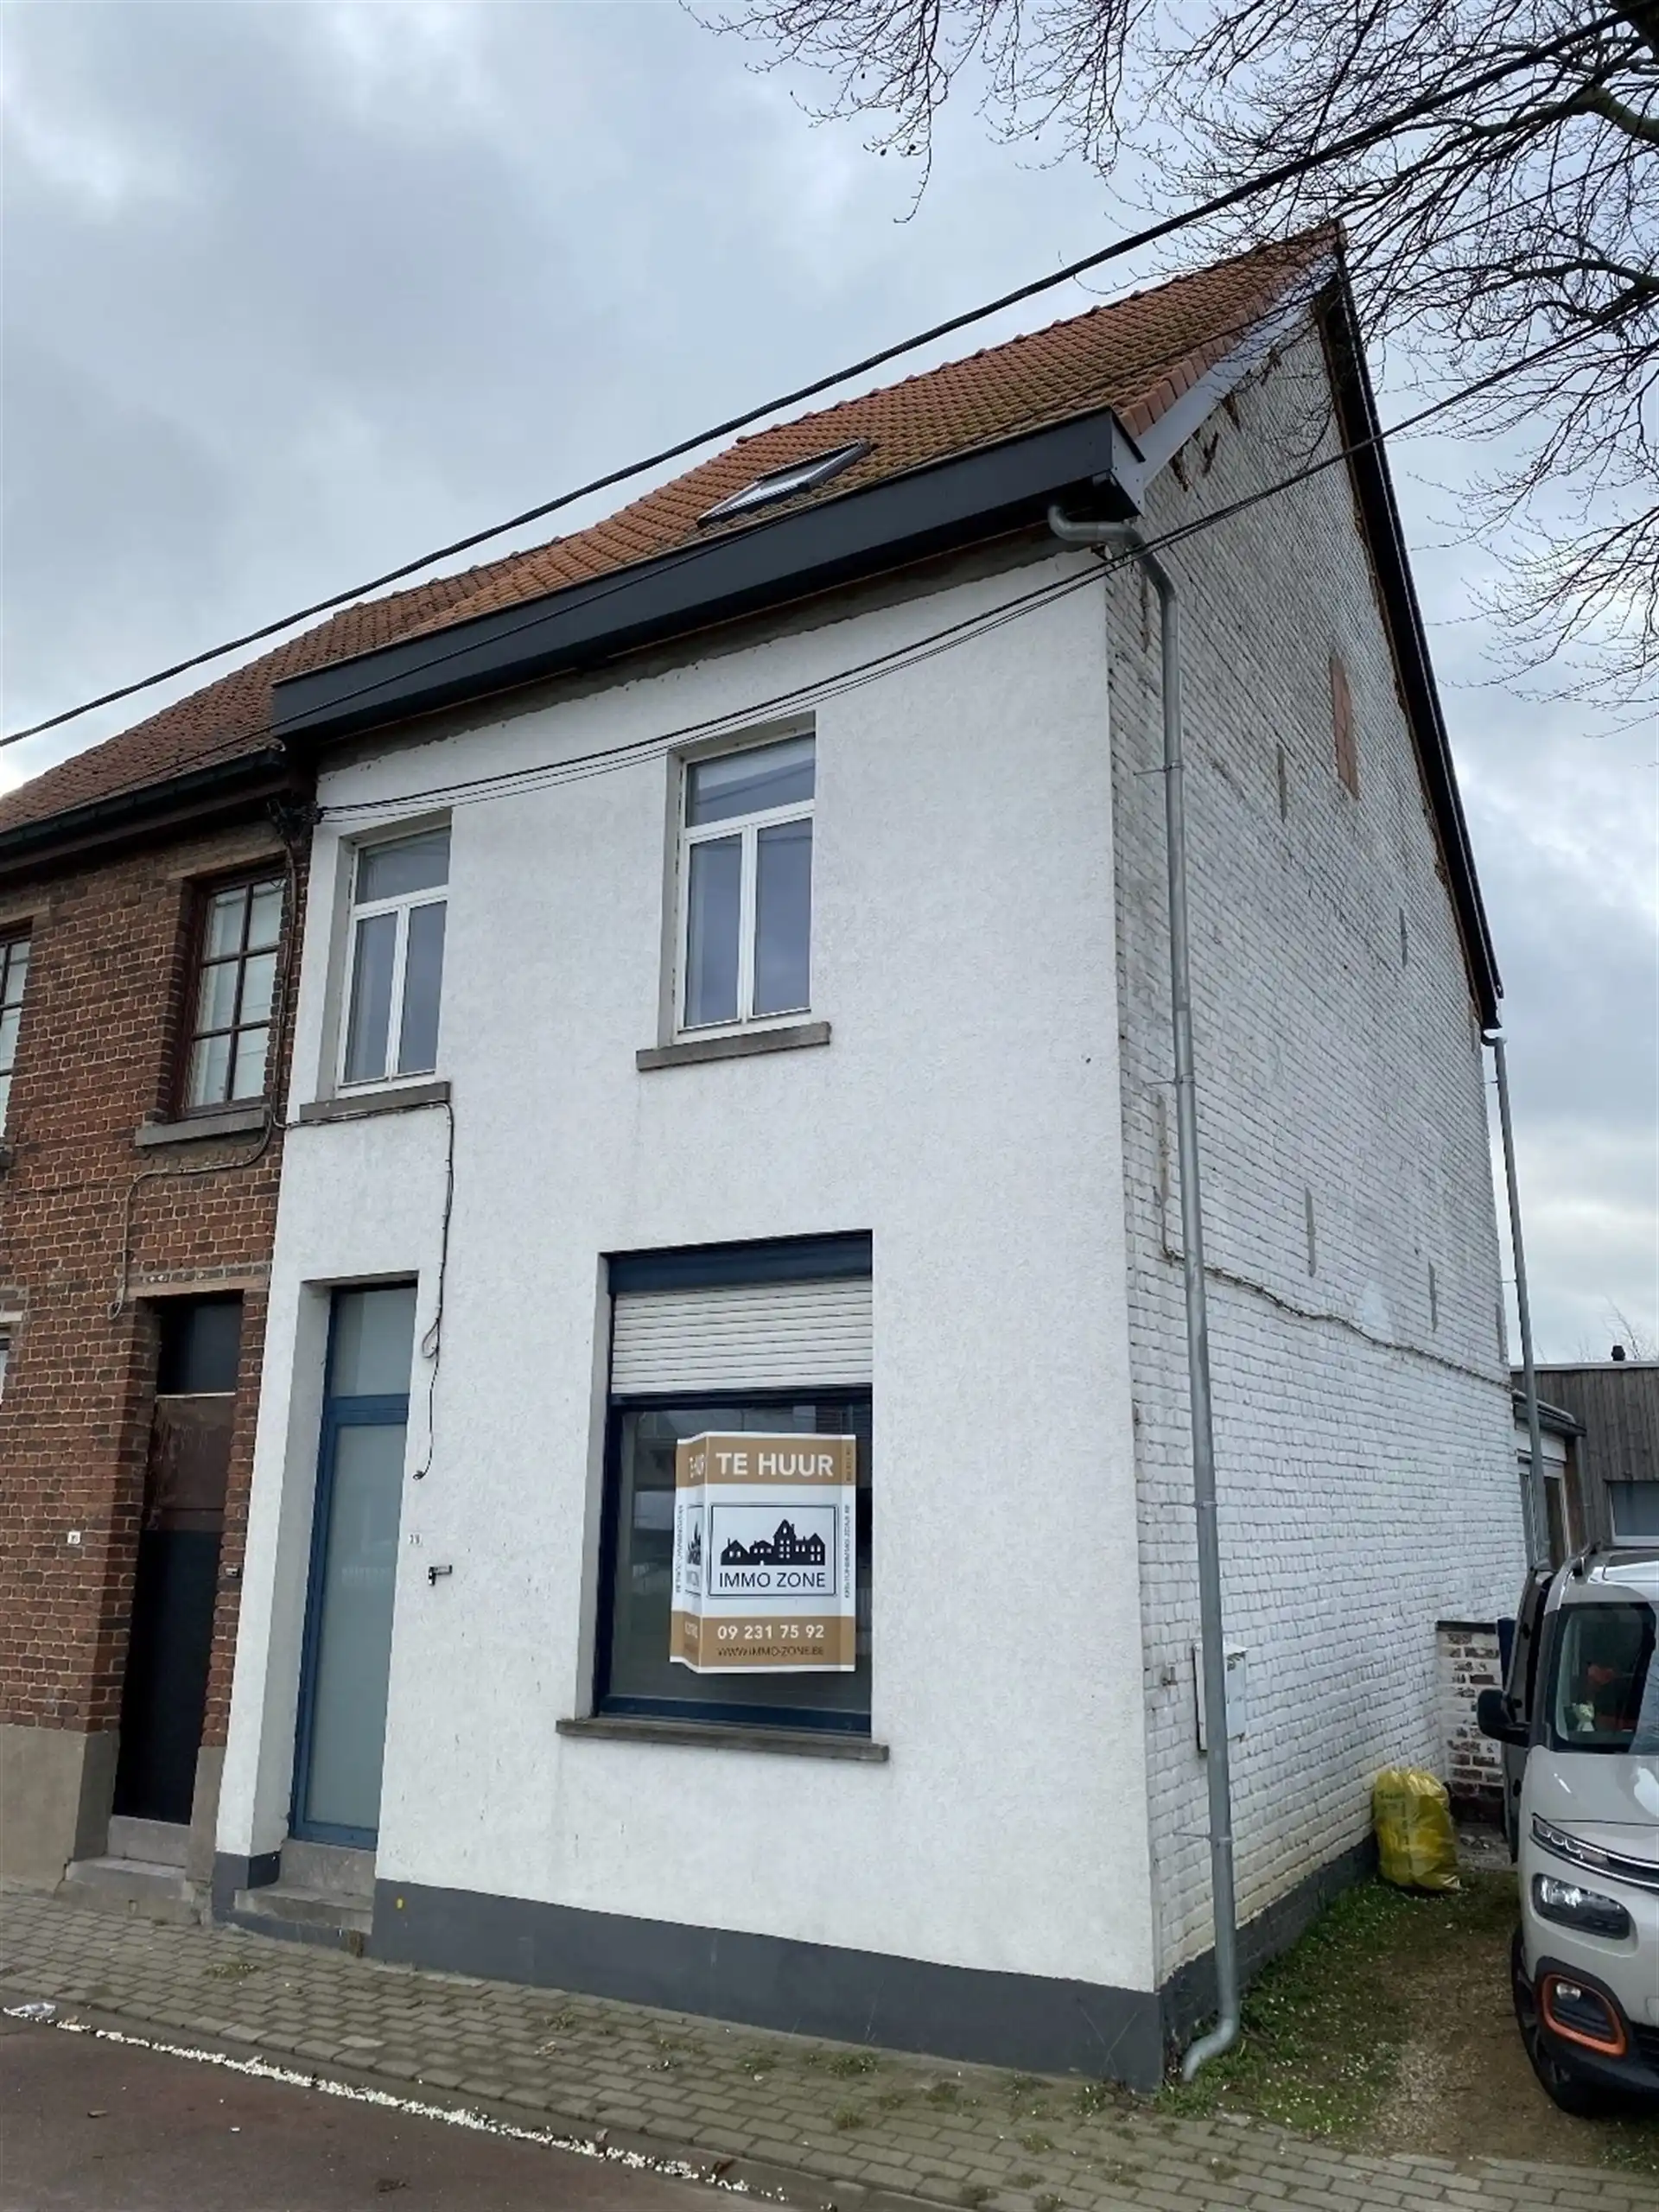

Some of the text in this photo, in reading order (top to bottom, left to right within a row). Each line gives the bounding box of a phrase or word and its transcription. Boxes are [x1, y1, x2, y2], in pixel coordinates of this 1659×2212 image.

[715, 1452, 747, 1475] TE
[758, 1452, 834, 1477] HUUR
[719, 1572, 771, 1588] IMMO
[776, 1572, 826, 1588] ZONE
[717, 1624, 824, 1640] 09 231 75 92
